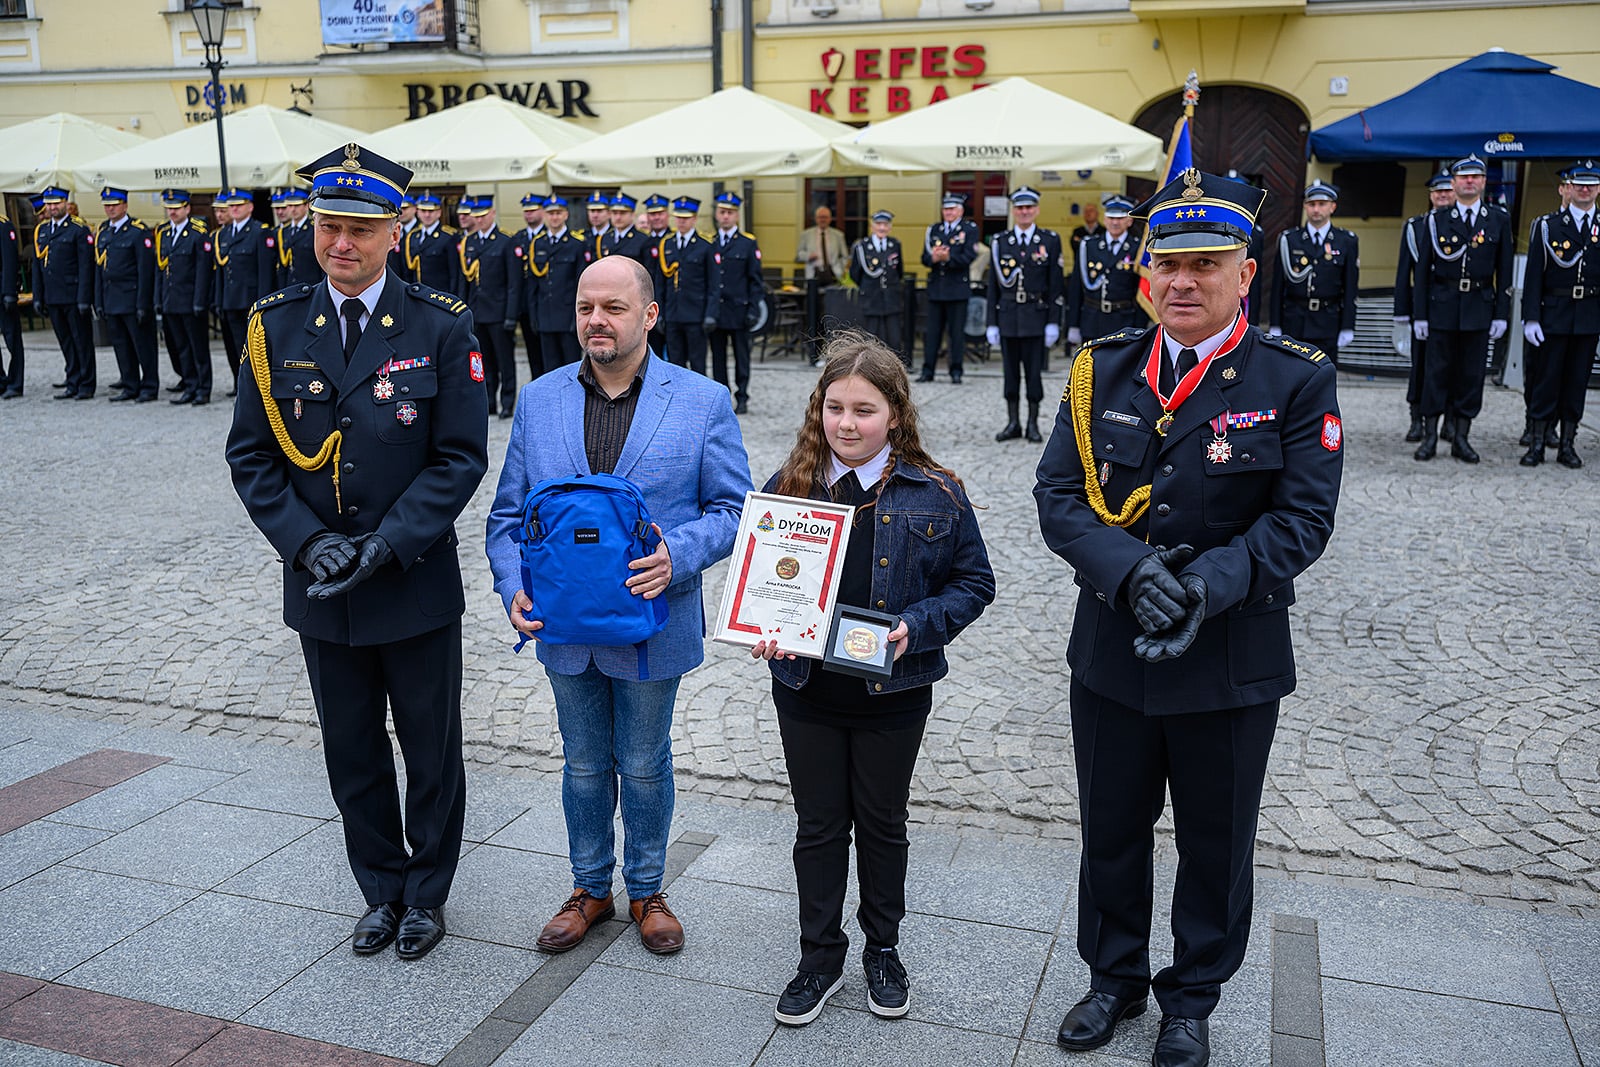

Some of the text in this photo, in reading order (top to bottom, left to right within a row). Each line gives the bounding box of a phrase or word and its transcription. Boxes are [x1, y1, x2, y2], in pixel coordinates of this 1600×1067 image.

[354, 0, 373, 13] 40
[327, 16, 353, 26] DOMU
[855, 45, 986, 80] EFES
[403, 79, 599, 121] BROWAR
[810, 84, 993, 114] KEBA
[956, 145, 1024, 159] BROWAR
[1484, 139, 1525, 154] Corona
[656, 155, 714, 169] BROWAR
[155, 167, 200, 179] BROWAR
[778, 519, 831, 537] DYPLOM
